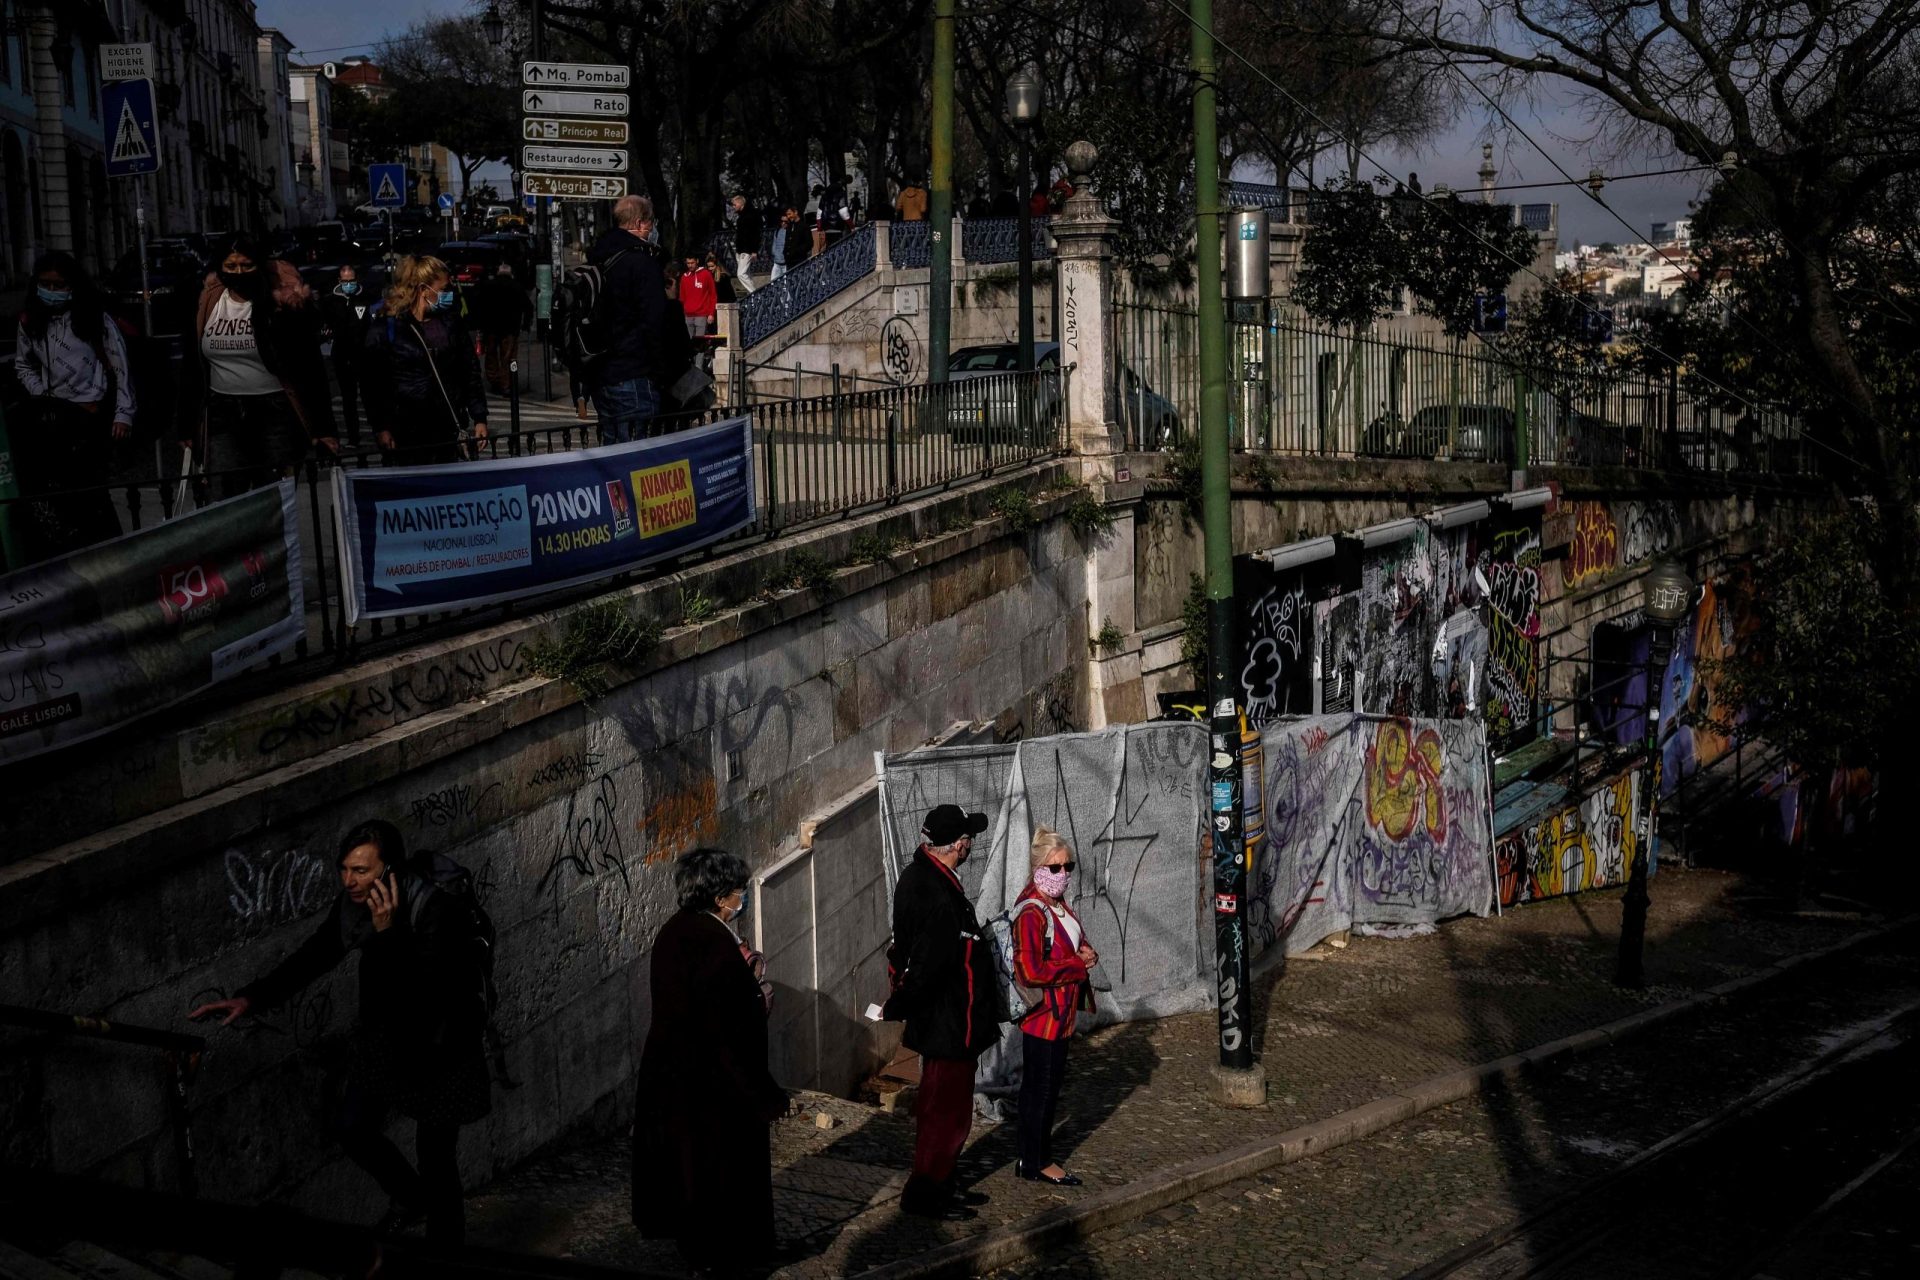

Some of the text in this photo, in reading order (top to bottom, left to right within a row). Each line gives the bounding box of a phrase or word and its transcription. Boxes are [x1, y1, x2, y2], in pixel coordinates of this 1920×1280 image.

[107, 47, 142, 56] EXCETO
[107, 58, 145, 67] HIGIENE
[108, 69, 146, 77] URBANA
[547, 68, 626, 83] Mq. Pombal
[594, 98, 625, 111] Rato
[561, 125, 625, 138] Príncipe Real
[527, 152, 603, 165] Restauradores
[550, 179, 589, 194] Alegria
[206, 318, 255, 337] SUNSE
[209, 339, 257, 350] BOULEVARD
[640, 467, 688, 501] AVANÇAR
[383, 493, 523, 535] MANIFESTAÇÃO
[531, 484, 601, 527] 20 NOV
[640, 501, 650, 533] É
[650, 494, 695, 532] PRECISO!
[616, 518, 631, 532] CGTP
[423, 532, 499, 552] NACIONAL (LISBOA)
[538, 523, 612, 556] 14.30 HORAS
[385, 559, 429, 577] MARQUÊS
[429, 559, 440, 572] DE
[441, 556, 472, 570] POMBAL
[476, 547, 530, 566] RESTAURADORES
[170, 564, 208, 613] 50
[34, 703, 73, 723] LISBOA
